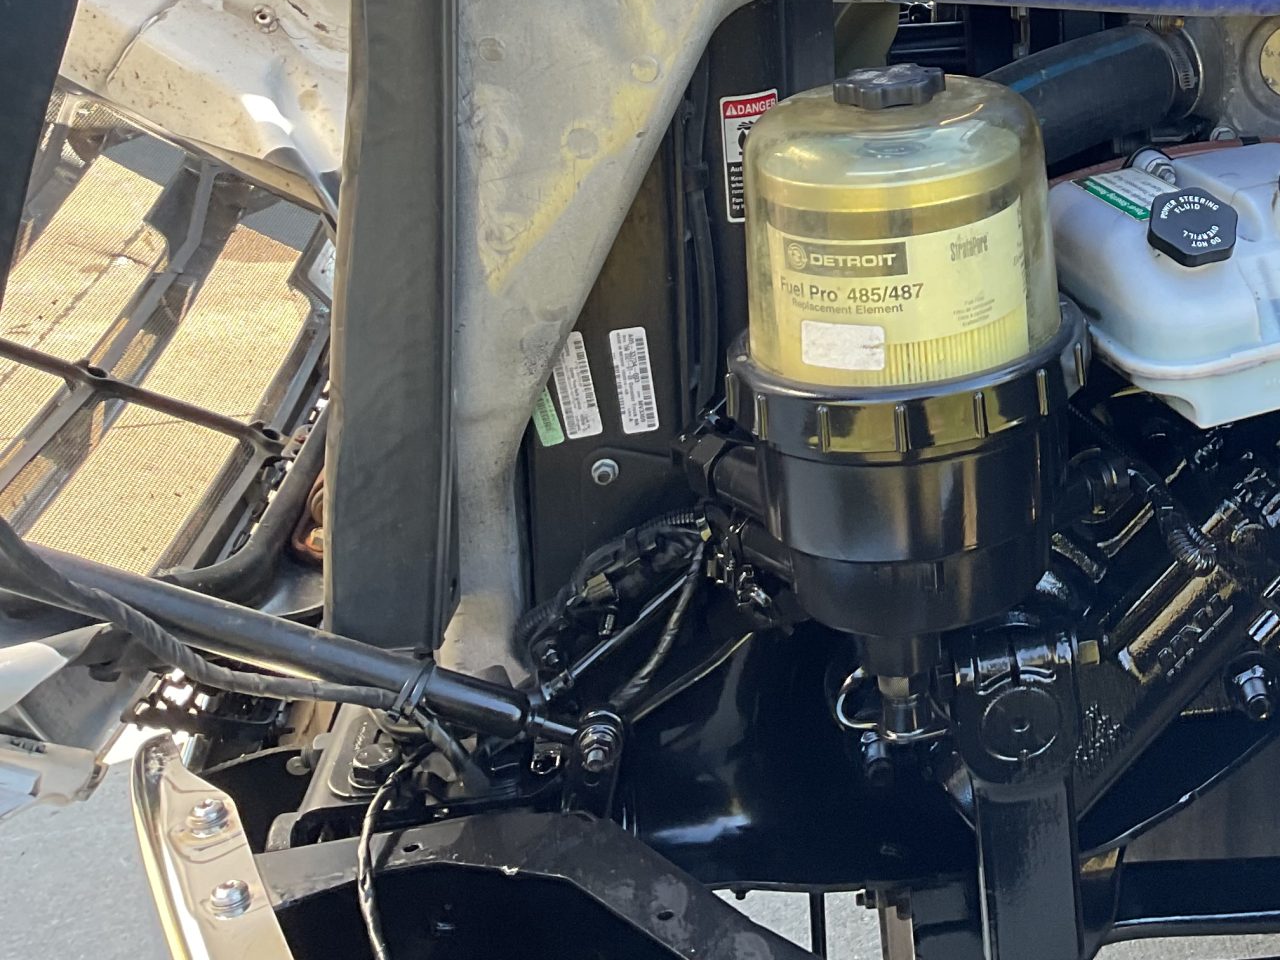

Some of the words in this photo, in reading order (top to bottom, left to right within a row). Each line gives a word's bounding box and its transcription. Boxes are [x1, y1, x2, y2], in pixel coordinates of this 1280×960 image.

[736, 98, 776, 115] DANGER
[1160, 200, 1178, 219] POWER
[1178, 196, 1220, 211] STEERING
[1174, 203, 1200, 214] FLUID
[1182, 226, 1219, 240] OVERFILL
[1210, 236, 1222, 244] DO
[809, 253, 897, 268] DETROIT
[780, 276, 804, 298] Fuel
[809, 285, 838, 303] Pro
[847, 282, 924, 304] 485/487
[792, 298, 852, 314] Replacement
[856, 303, 904, 316] Element
